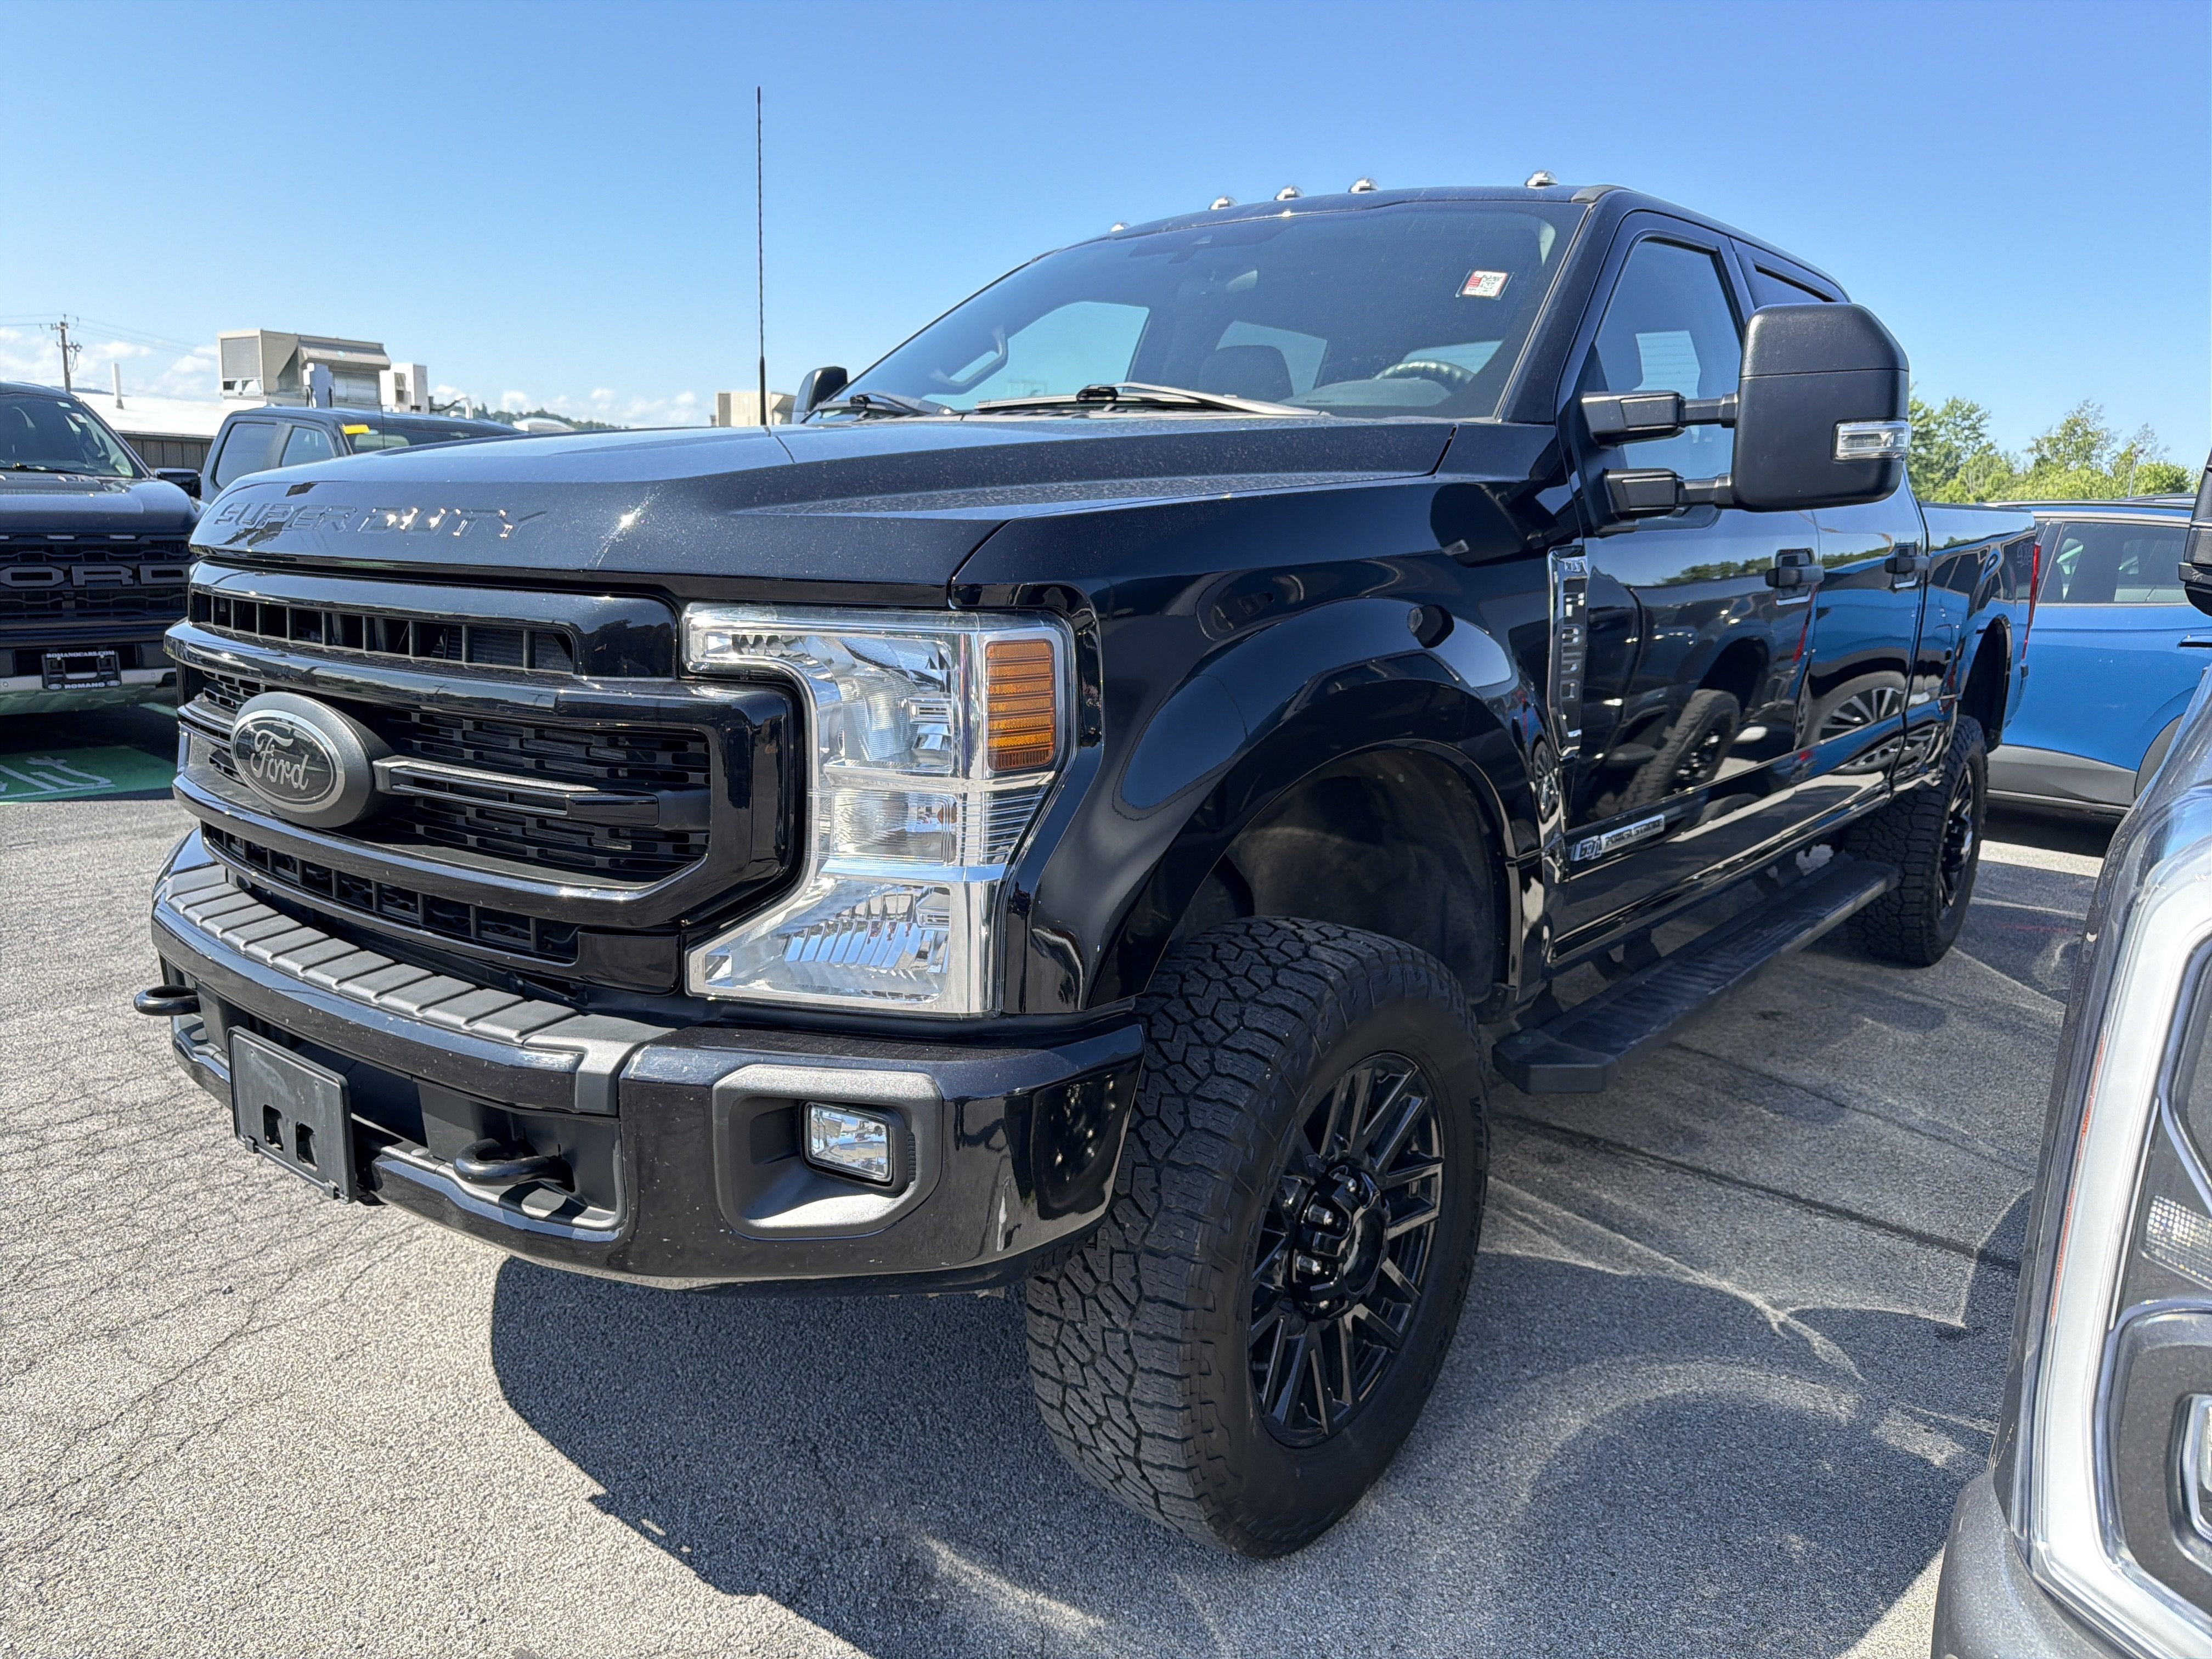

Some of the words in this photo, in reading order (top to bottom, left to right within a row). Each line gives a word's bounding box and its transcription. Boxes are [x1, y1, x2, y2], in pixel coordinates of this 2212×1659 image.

[214, 502, 357, 533] SUPER
[357, 507, 548, 538] DUTY
[0, 565, 190, 588] ORD
[250, 729, 309, 791] Ford
